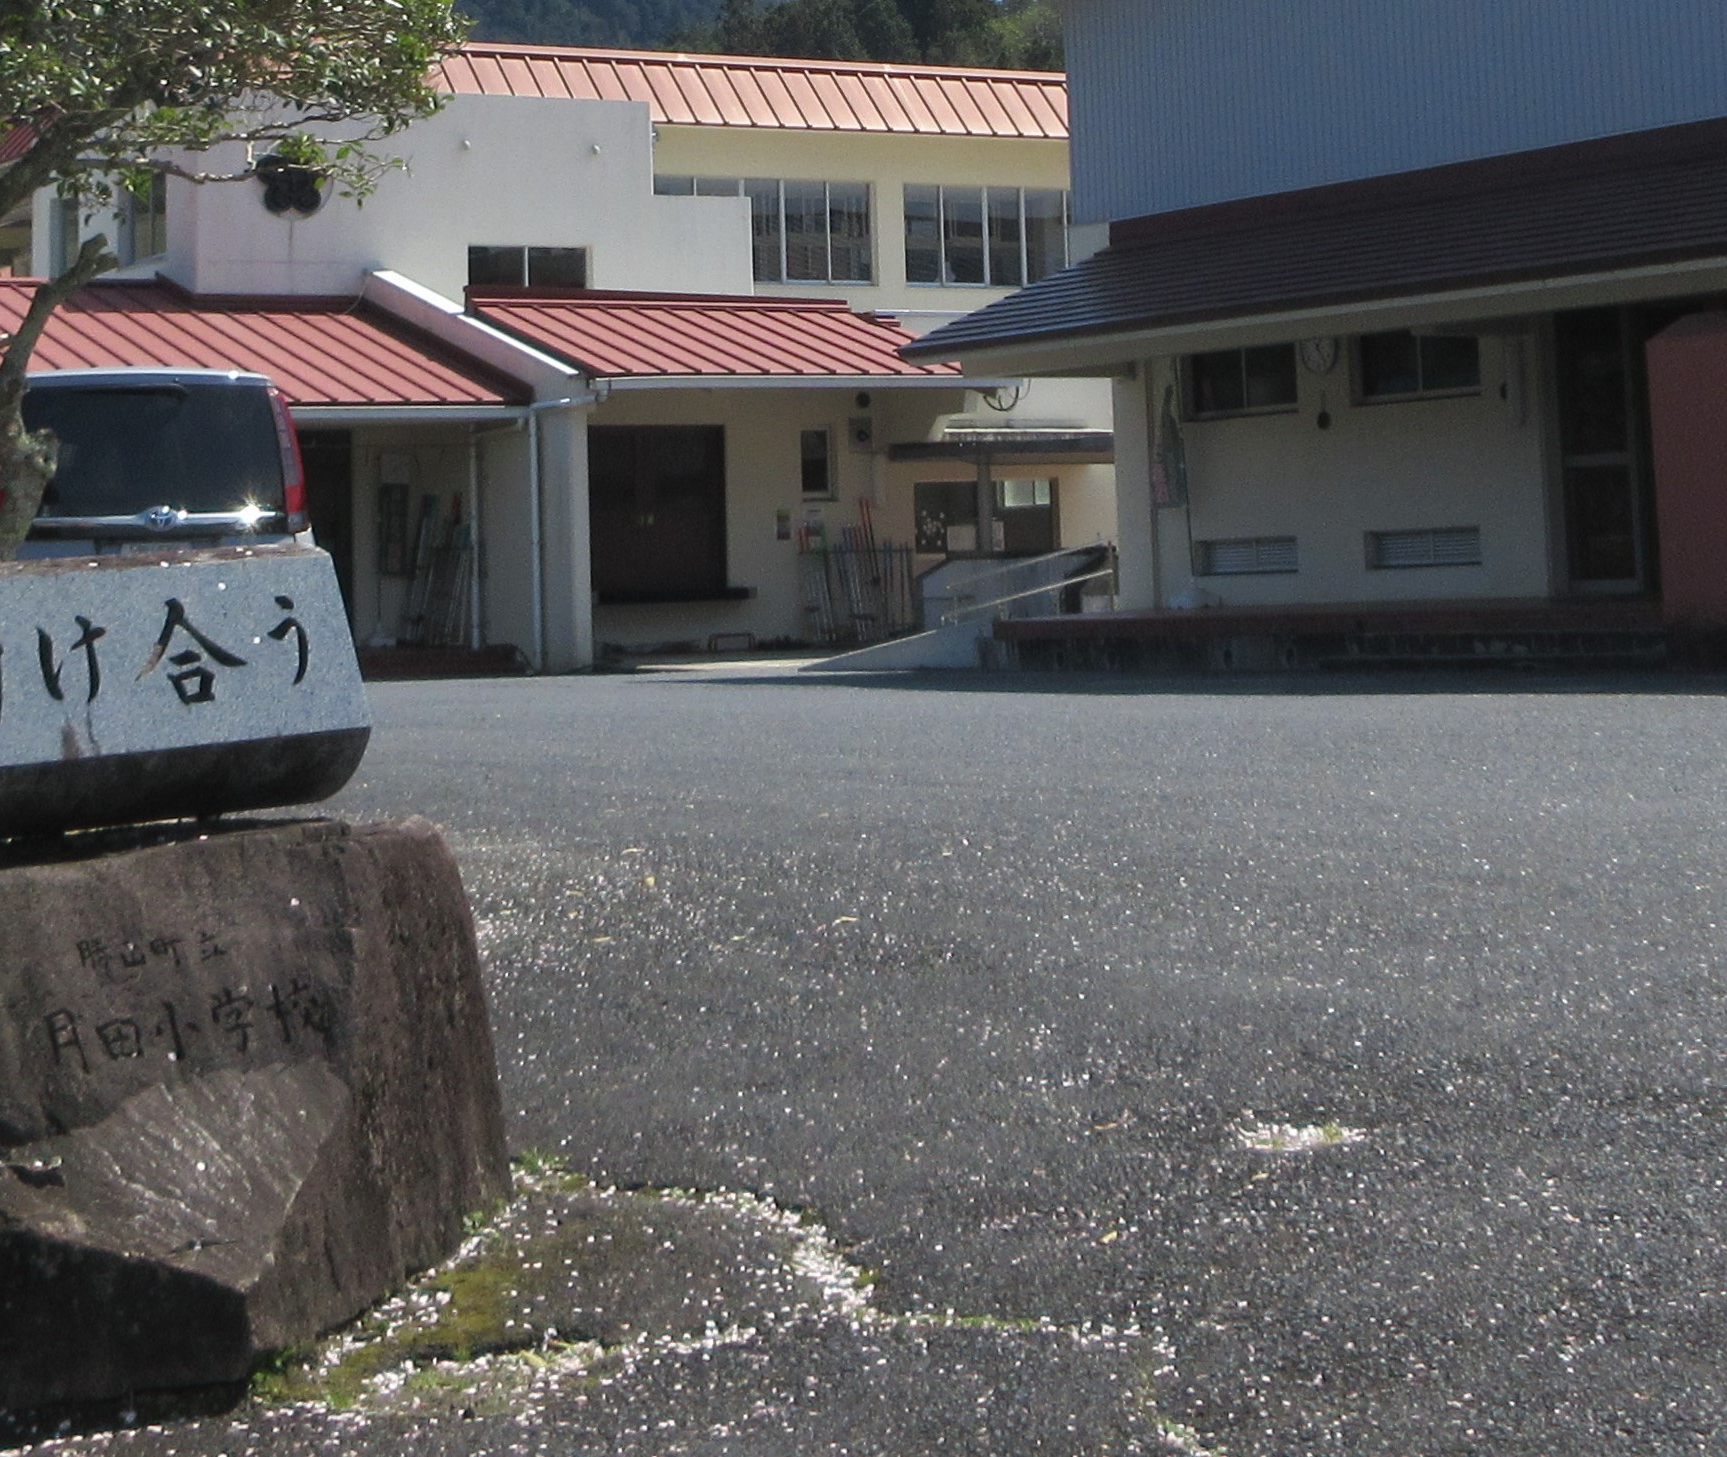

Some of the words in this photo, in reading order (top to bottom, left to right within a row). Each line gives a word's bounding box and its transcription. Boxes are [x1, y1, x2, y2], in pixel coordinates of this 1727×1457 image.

[76, 931, 228, 971] 勝山町立
[44, 976, 332, 1072] 月田小学校
